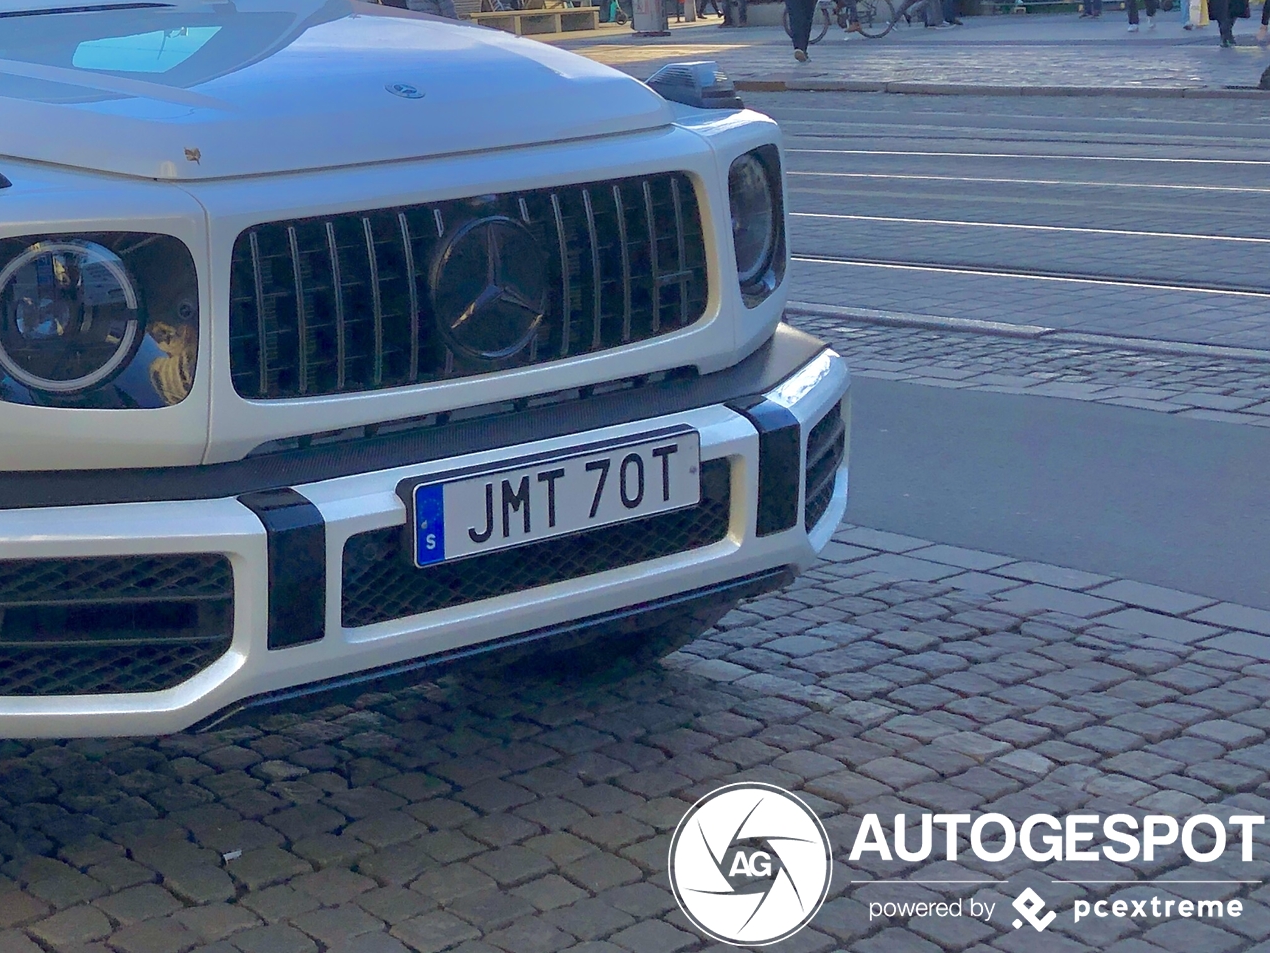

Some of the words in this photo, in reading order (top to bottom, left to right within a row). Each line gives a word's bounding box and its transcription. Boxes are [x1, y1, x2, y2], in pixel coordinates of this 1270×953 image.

[468, 468, 565, 543] JMT
[585, 444, 679, 518] 70T
[426, 533, 436, 550] S
